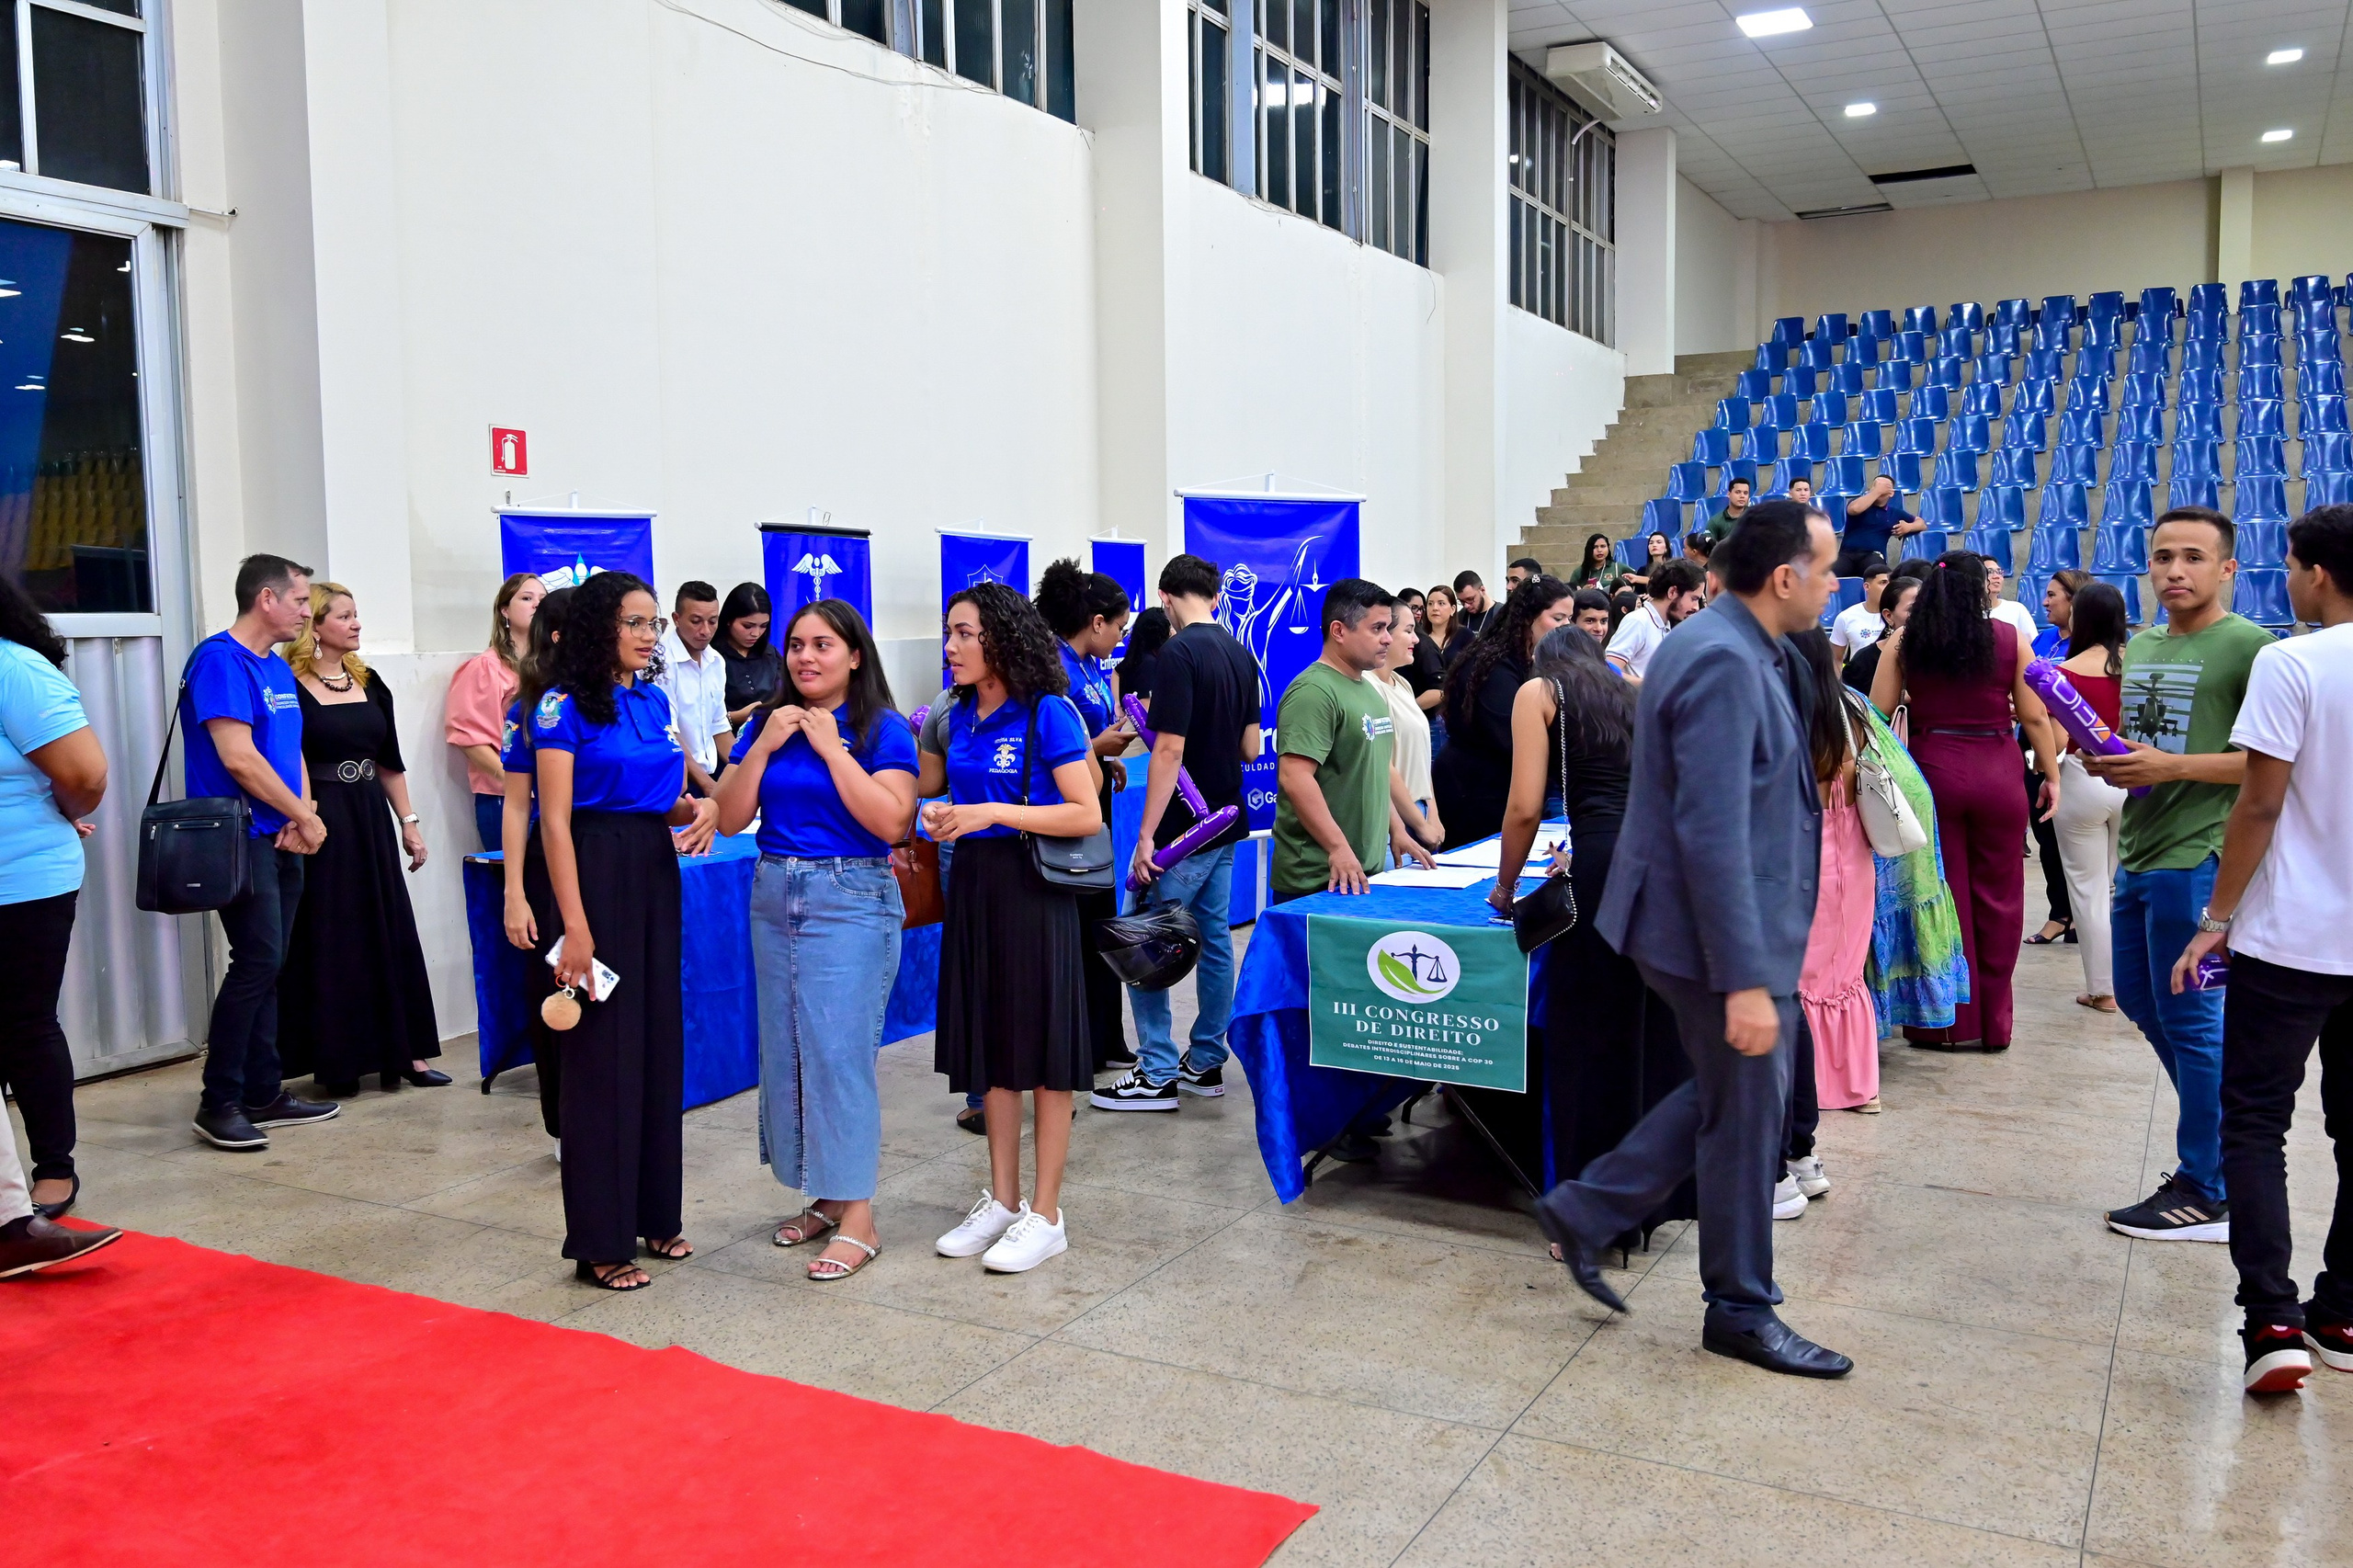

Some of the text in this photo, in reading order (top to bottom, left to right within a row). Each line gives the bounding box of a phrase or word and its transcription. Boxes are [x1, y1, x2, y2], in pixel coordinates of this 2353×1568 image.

[1333, 1001, 1499, 1031] III CONGRESSO
[1356, 1019, 1482, 1046] DE DIREITO
[1342, 1041, 1370, 1051] DEBATES
[1371, 1046, 1438, 1059] INTERDISCIPLINARES
[1367, 1039, 1393, 1047] DIREITO
[1398, 1042, 1464, 1056] SUSTENTABILIDADE:
